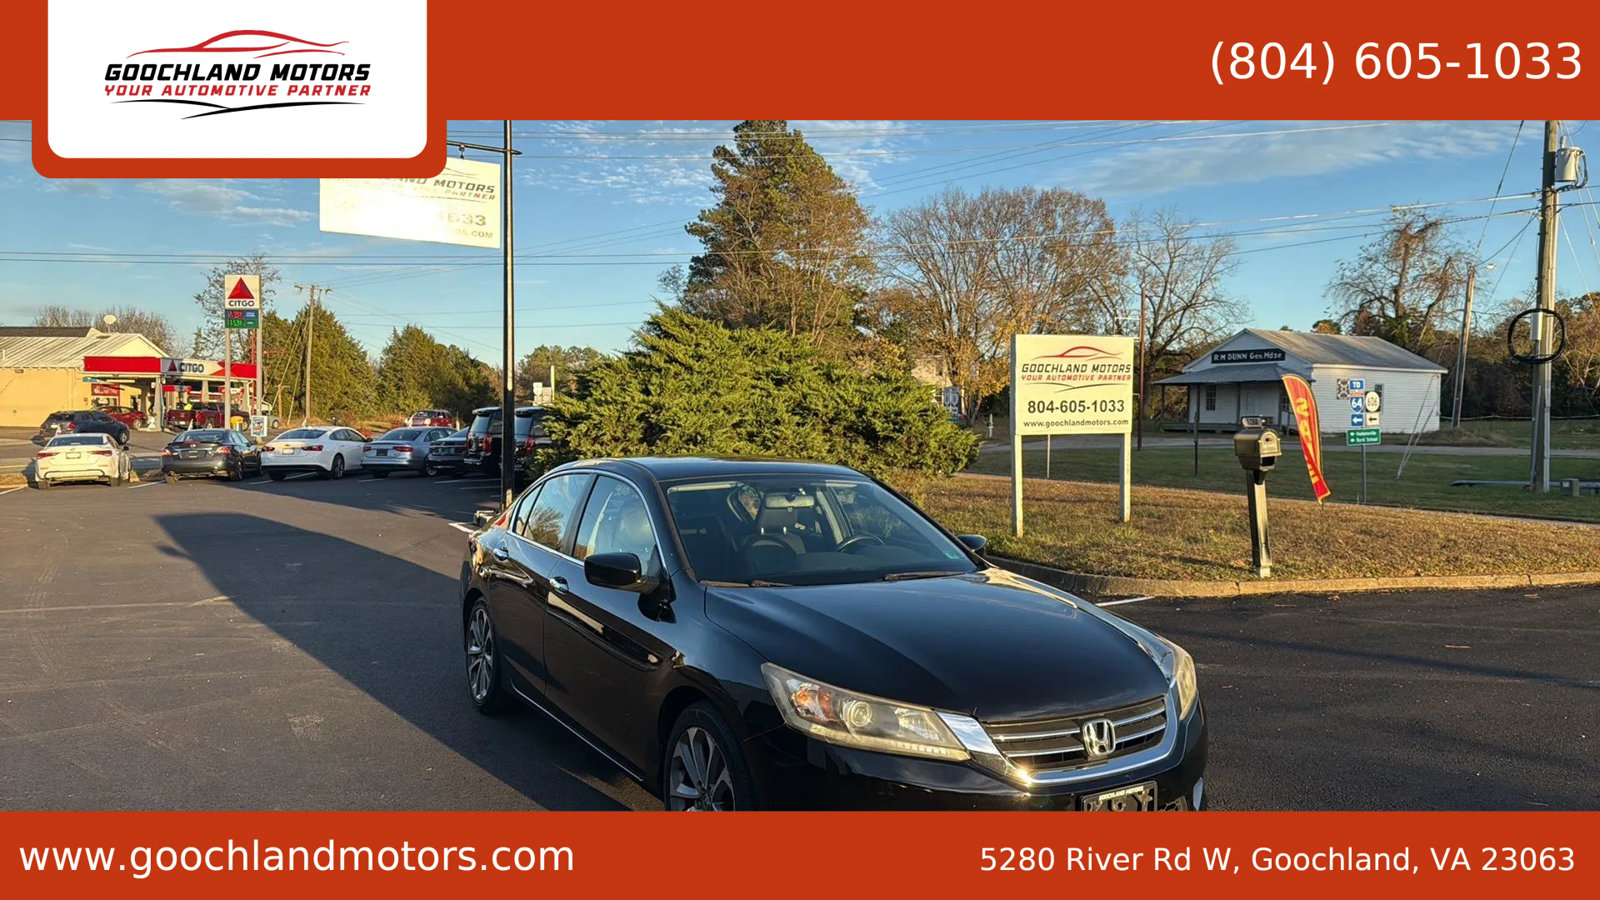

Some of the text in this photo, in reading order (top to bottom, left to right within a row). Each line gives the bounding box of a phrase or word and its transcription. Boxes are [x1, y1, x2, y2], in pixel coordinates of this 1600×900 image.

[434, 179, 496, 194] MOTORS
[179, 362, 205, 374] CITGO
[1021, 363, 1132, 373] GOOCHLAND MOTORS
[1027, 400, 1125, 414] 804-605-1033
[1351, 397, 1363, 409] 64
[1023, 419, 1129, 429] www.goochlandmotors.com
